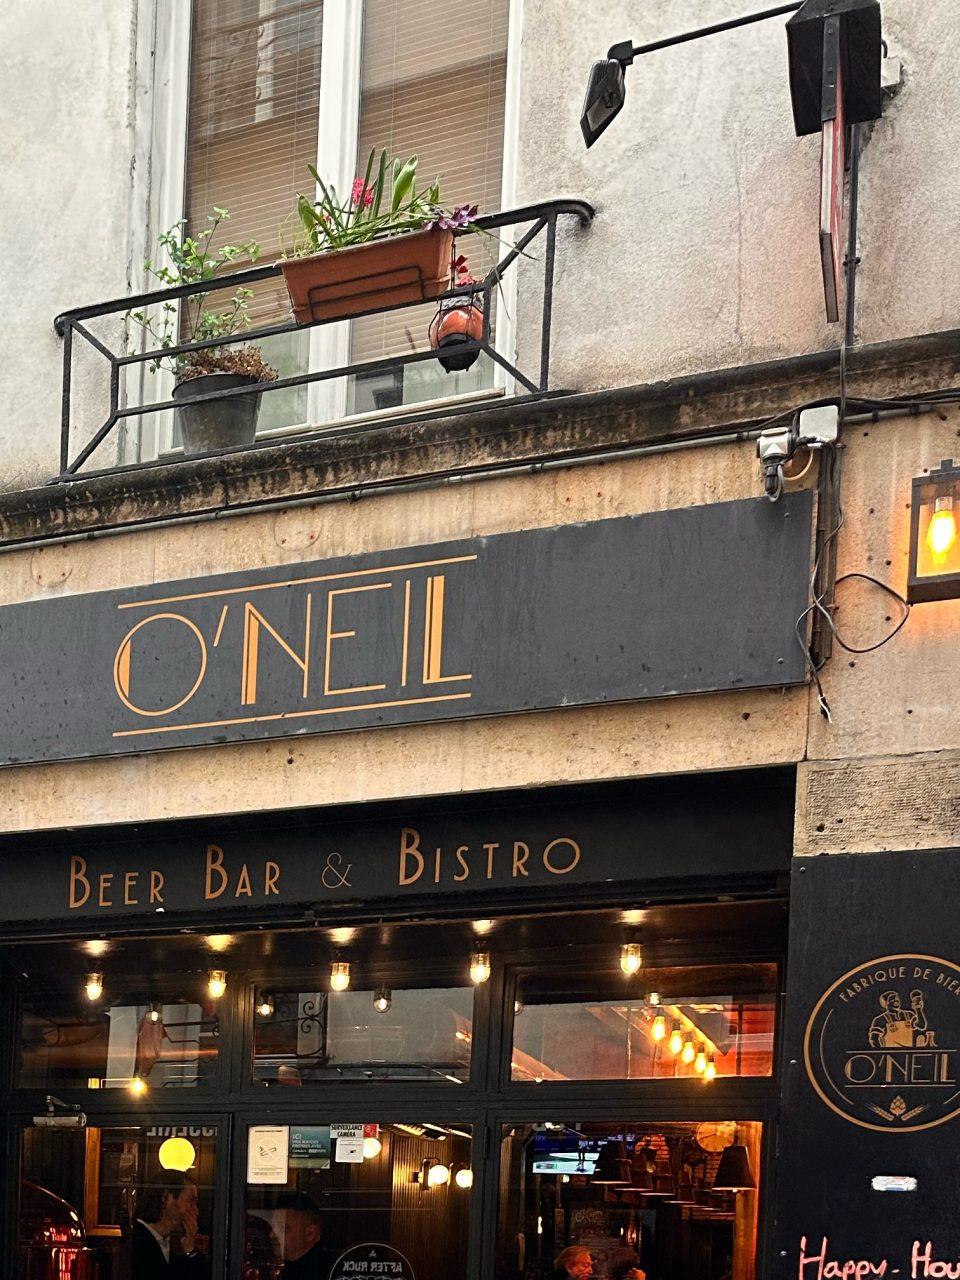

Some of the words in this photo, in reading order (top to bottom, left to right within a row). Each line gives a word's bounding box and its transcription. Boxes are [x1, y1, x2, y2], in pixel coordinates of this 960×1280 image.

[113, 575, 472, 717] O'NEIL
[69, 855, 165, 909] BEER
[204, 844, 280, 900] BAR
[321, 852, 352, 889] &
[398, 827, 581, 886] BISTRO
[839, 966, 906, 1002] FABRIQUE
[913, 967, 932, 980] DE
[844, 1053, 956, 1083] O'NEIL
